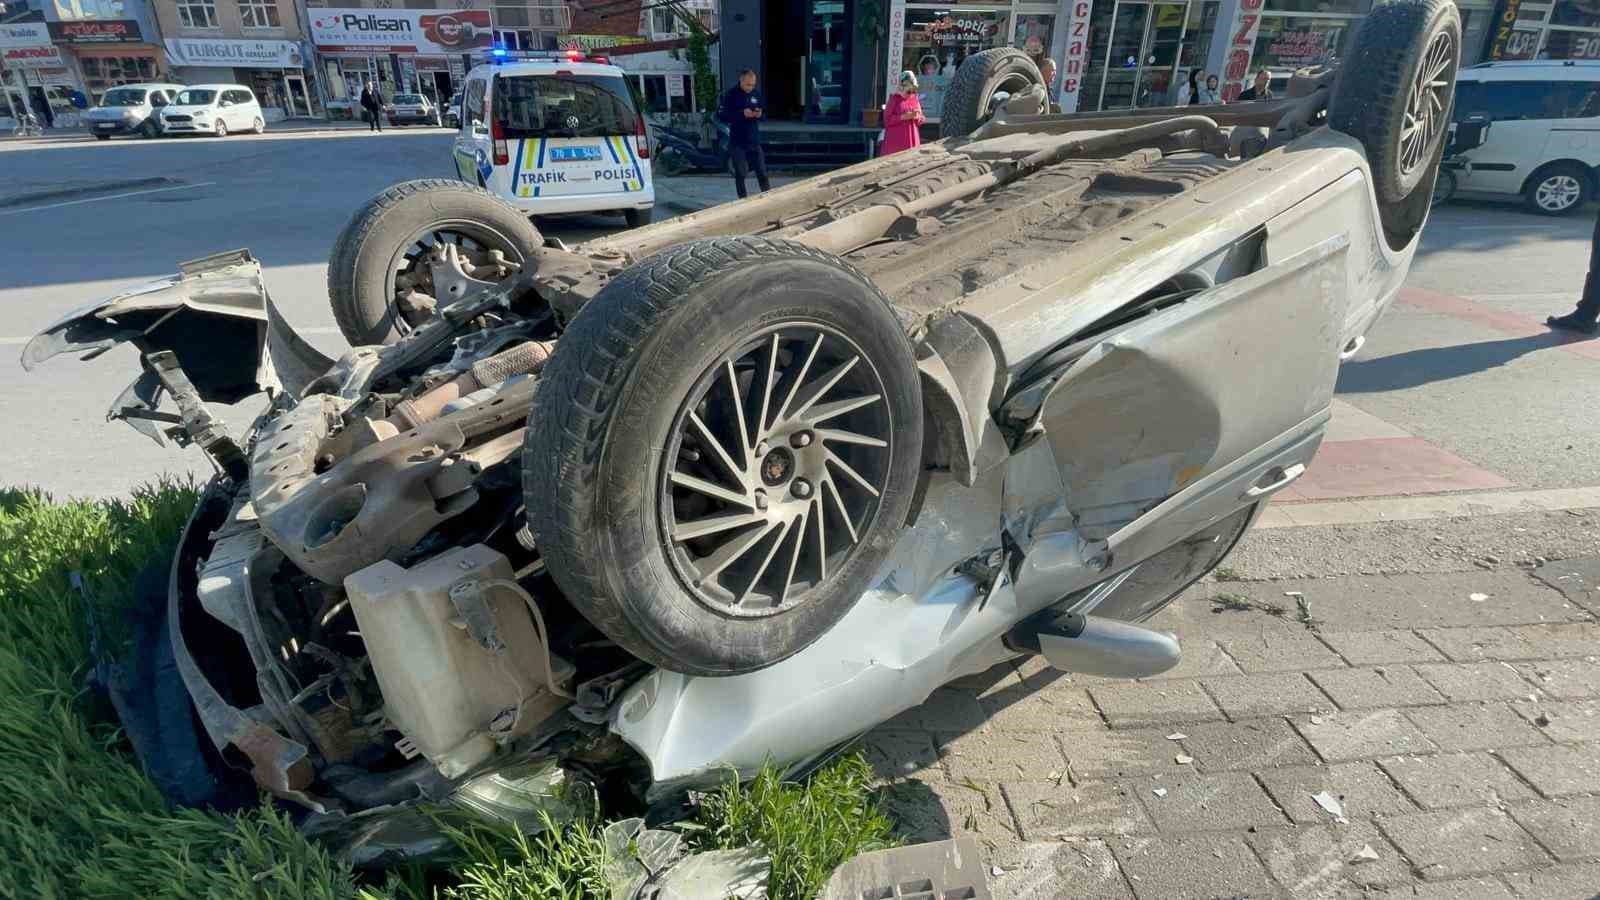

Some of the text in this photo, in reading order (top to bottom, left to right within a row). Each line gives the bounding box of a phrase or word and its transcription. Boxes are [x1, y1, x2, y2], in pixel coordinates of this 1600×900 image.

[343, 14, 411, 32] Polisan
[957, 18, 989, 36] optik
[185, 43, 244, 57] TURGUT
[521, 168, 567, 185] TRAFİK
